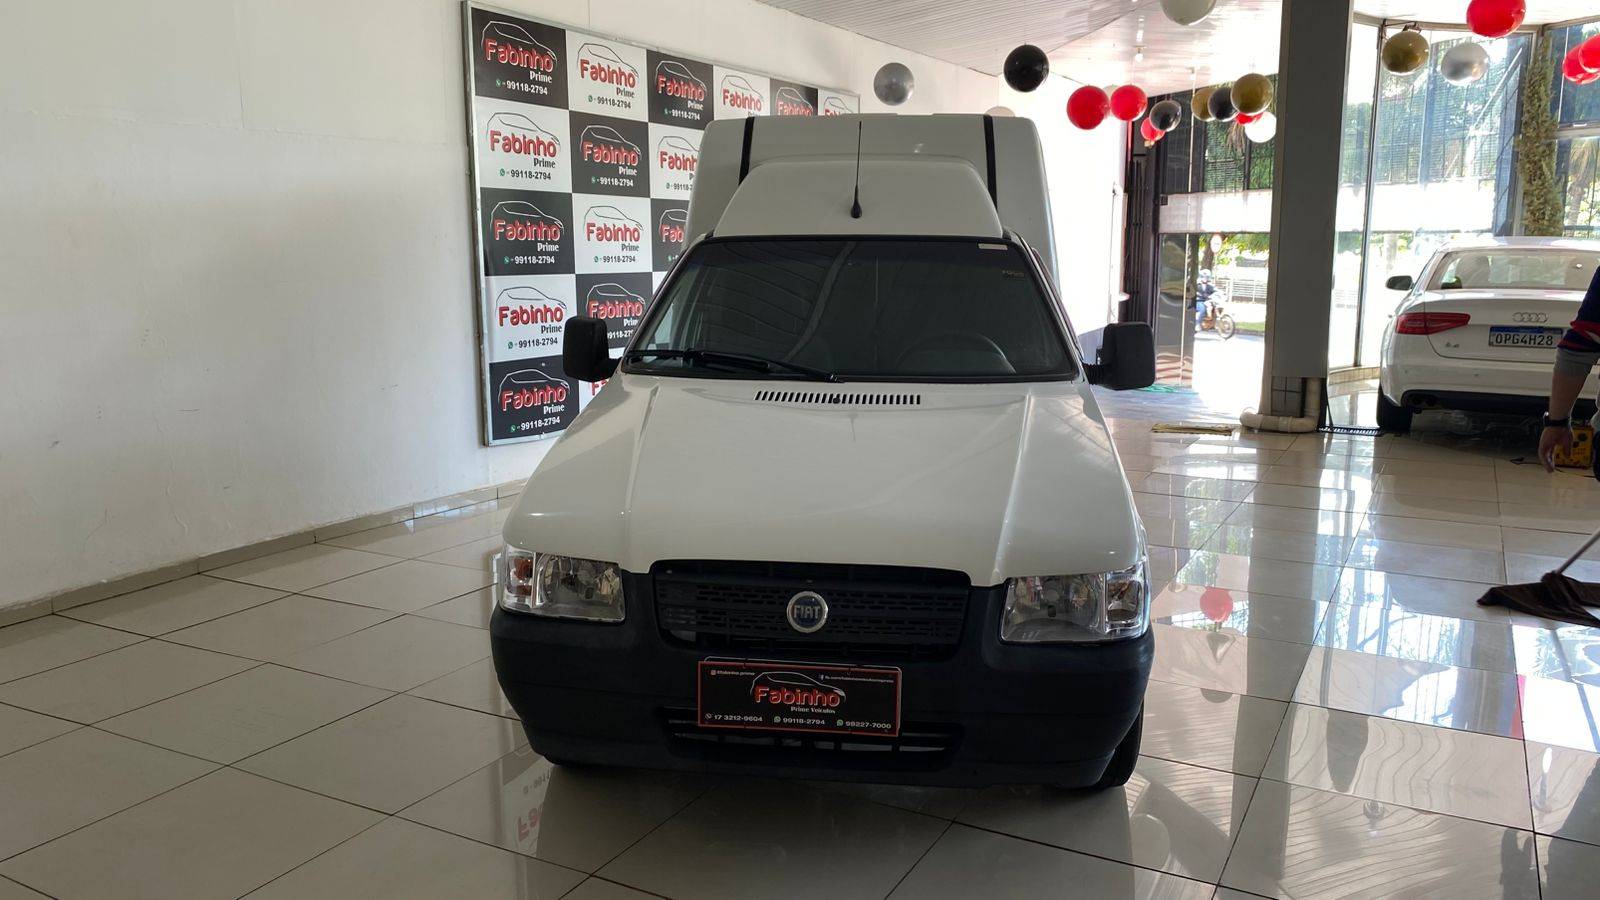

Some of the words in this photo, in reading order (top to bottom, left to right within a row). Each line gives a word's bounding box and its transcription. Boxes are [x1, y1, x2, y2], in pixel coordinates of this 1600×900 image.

[484, 38, 554, 72] Fabinho
[529, 71, 553, 83] Prime
[580, 58, 636, 88] Fabinho
[506, 80, 549, 95] 99118-2794
[616, 87, 635, 98] Prime
[657, 74, 705, 102] Fabinho
[597, 96, 632, 109] 99118-2794
[722, 89, 762, 111] Fabinho
[489, 130, 558, 158] Fabinho
[582, 141, 639, 167] Fabinho
[533, 157, 556, 168] Prime
[510, 169, 552, 181] 99118-2794
[618, 166, 638, 176] Prime
[493, 219, 561, 241] Fabinho
[585, 222, 641, 242] Fabinho
[537, 242, 560, 252] Prime
[621, 243, 640, 252] Prime
[514, 256, 556, 265] 99118-2794
[602, 255, 636, 264] 99118-2794
[497, 304, 564, 327] Fabinho
[588, 300, 643, 319] Fabinho
[540, 324, 563, 334] Prime
[623, 319, 638, 328] Prim
[518, 337, 559, 349] 99118-2794
[1494, 333, 1554, 346] OPG4H28
[501, 385, 567, 412] Fabinho
[543, 404, 566, 415] Prime
[520, 416, 561, 431] 99118-2794
[793, 604, 821, 619] FIAT
[754, 685, 842, 707] Fabinho
